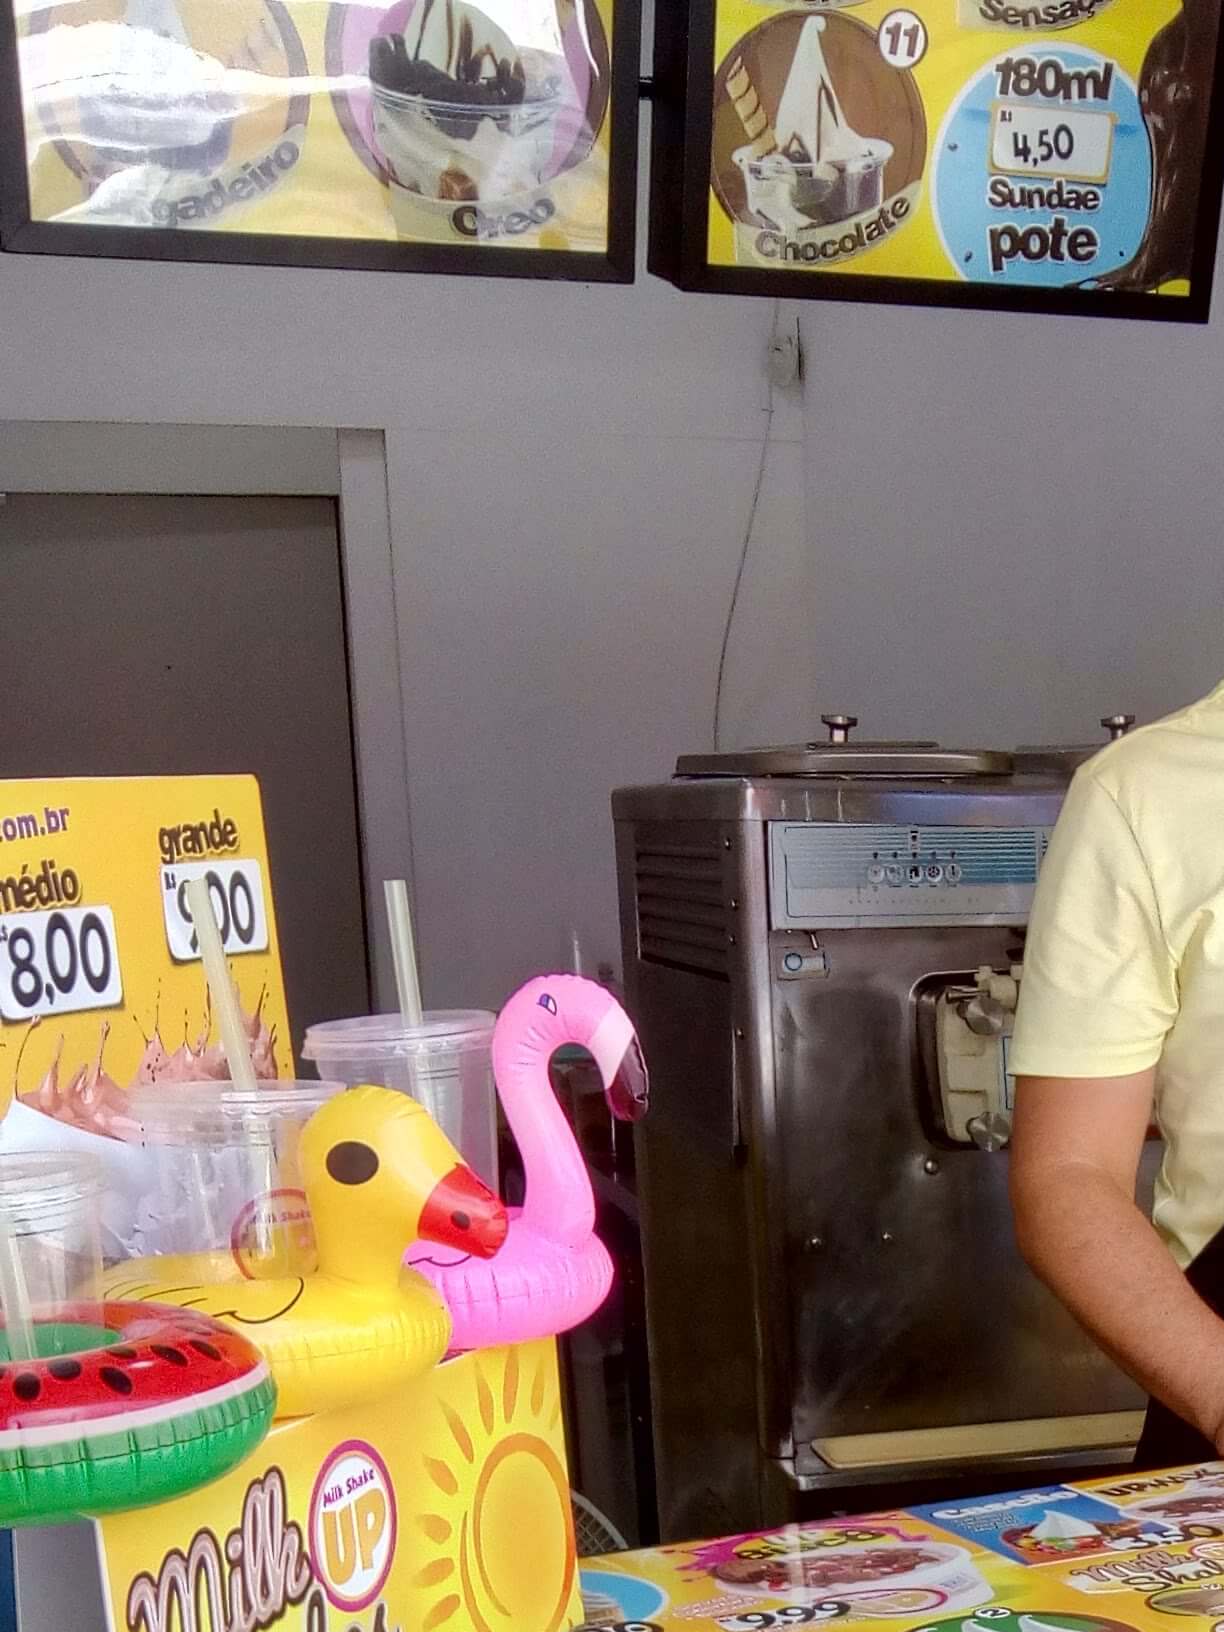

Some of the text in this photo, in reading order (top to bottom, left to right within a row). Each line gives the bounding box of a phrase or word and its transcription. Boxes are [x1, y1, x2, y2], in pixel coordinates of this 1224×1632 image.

[887, 22, 920, 57] 11
[996, 57, 1114, 101] 180ml
[1013, 123, 1075, 167] 4,50
[989, 177, 1101, 211] Sundae
[755, 197, 911, 262] Chocolate
[989, 216, 1098, 272] pote
[159, 808, 239, 864] grande
[8, 911, 111, 1008] 8,00
[346, 1467, 375, 1494] Shake
[322, 1487, 386, 1586] UP
